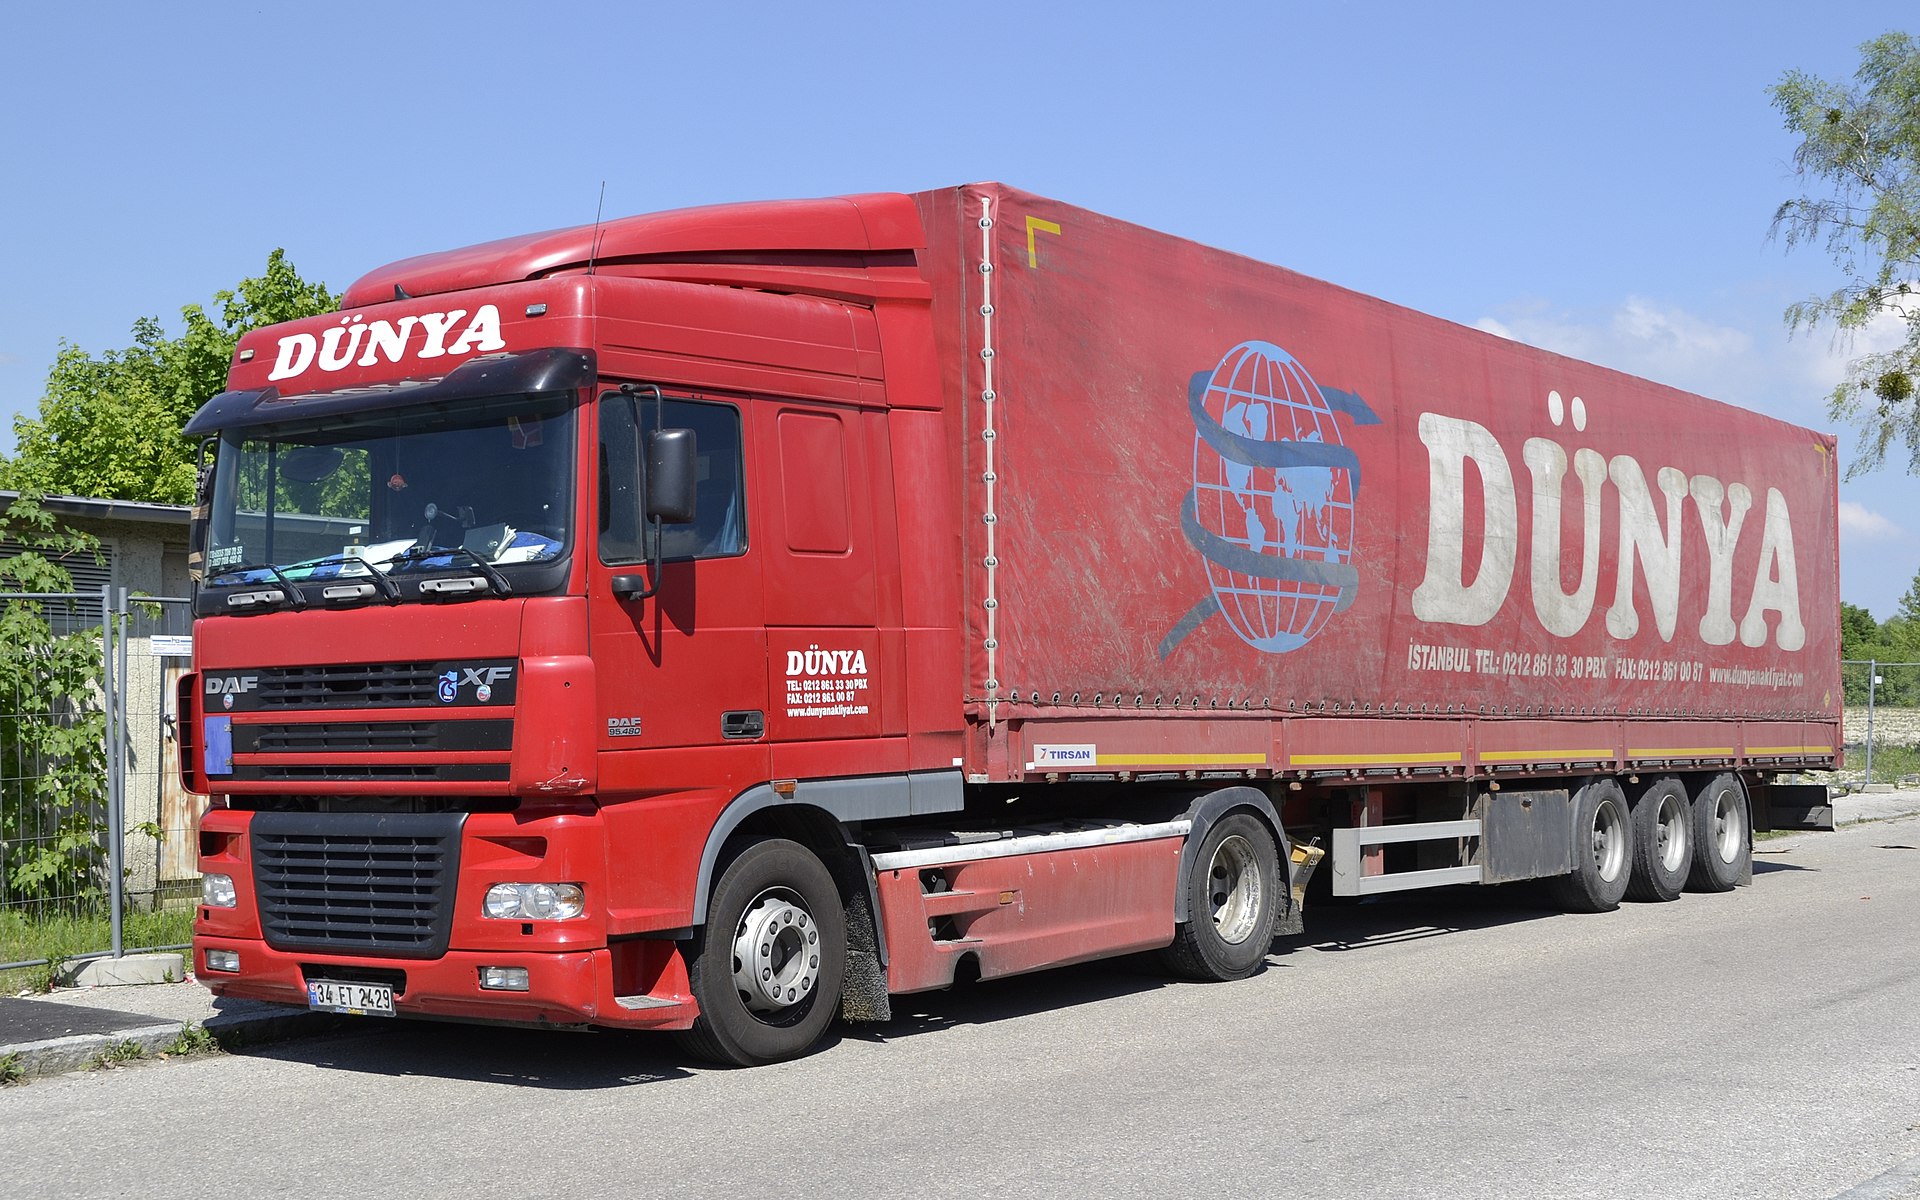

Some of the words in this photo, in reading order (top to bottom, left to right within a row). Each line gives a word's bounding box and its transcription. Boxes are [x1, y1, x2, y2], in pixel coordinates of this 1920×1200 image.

[268, 304, 506, 381] DÜNYA
[1412, 390, 1806, 651] DÜNYA
[785, 644, 868, 676] DÜNYA
[1407, 637, 1471, 673] İSTANBUL
[1475, 648, 1500, 675] TEL:
[1502, 651, 1530, 676] 0212
[1532, 653, 1552, 677] 861
[1555, 654, 1568, 677] 33
[1570, 655, 1584, 679] 30
[1585, 656, 1608, 679] PBX
[1615, 657, 1637, 680] FAX:
[1638, 658, 1660, 681] 0212
[1662, 660, 1678, 682] 861
[1680, 661, 1692, 682] 00
[1693, 662, 1704, 683] 87
[1709, 664, 1804, 691] www.dunyanakliyat.com
[205, 675, 258, 695] DAF
[457, 666, 513, 686] XF
[786, 680, 802, 691] TEL:
[803, 680, 820, 691] 0212
[821, 679, 835, 690] 861
[835, 679, 844, 690] 33
[845, 679, 854, 690] 30
[854, 678, 868, 690] PBX
[786, 693, 803, 704] FAX:
[803, 692, 821, 703] 0212
[822, 692, 835, 703] 861
[836, 691, 845, 702] 00
[846, 690, 855, 701] 87
[786, 704, 869, 718] www.dunyanakliyat.com
[608, 717, 641, 727] DAF
[609, 728, 641, 736] 95.480
[1049, 750, 1090, 759] TIRSAN
[317, 984, 333, 1004] 34
[338, 986, 353, 1006] ET
[358, 988, 390, 1009] 2429
